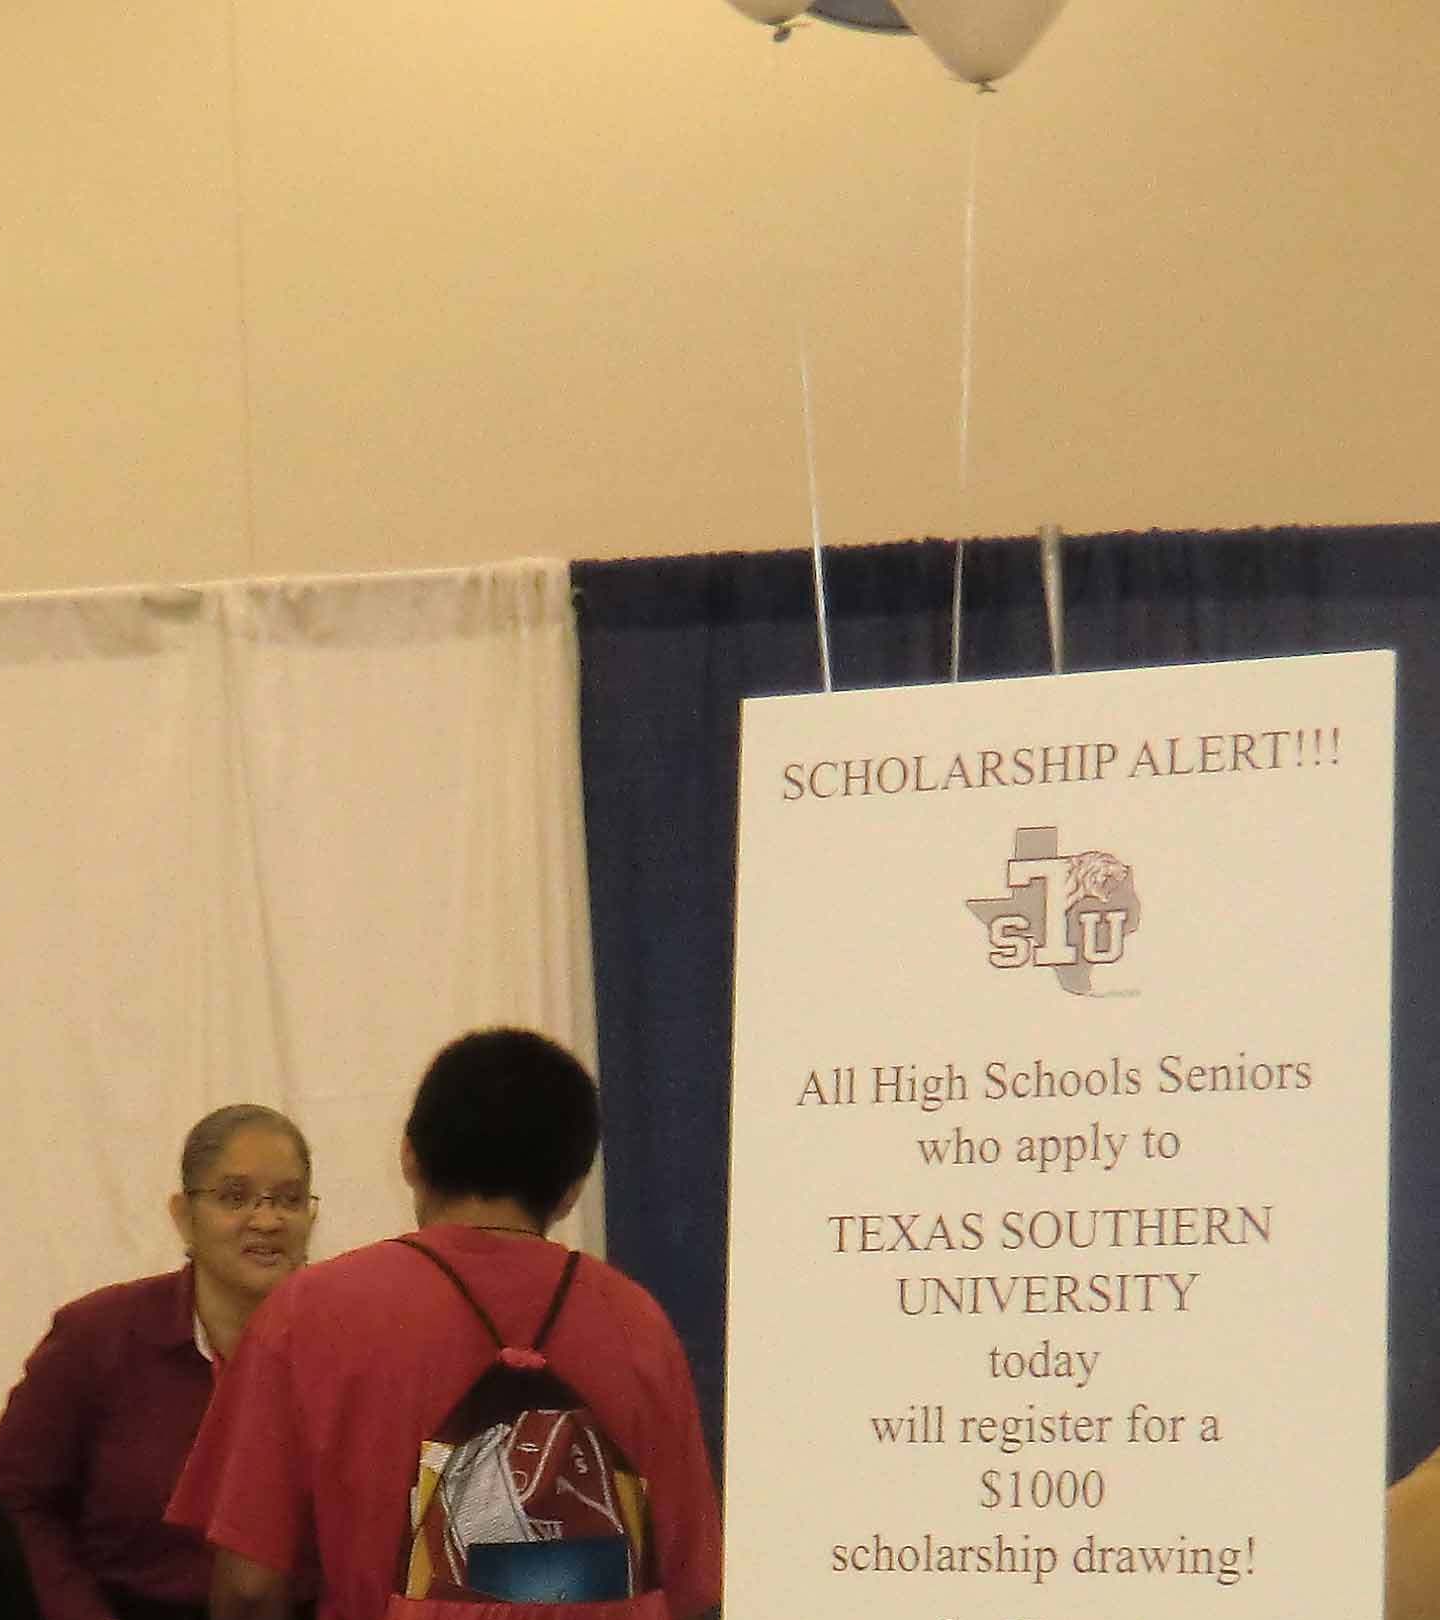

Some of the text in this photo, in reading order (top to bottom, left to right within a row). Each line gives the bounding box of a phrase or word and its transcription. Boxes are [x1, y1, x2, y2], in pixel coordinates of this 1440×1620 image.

[784, 728, 1338, 800] SCHOLARSHIP ALERT!!!
[796, 1052, 1311, 1112] All High Schools Seniors
[917, 1122, 1180, 1173] who apply to
[828, 1206, 1272, 1252] TEXAS SOUTHERN
[896, 1273, 1200, 1315] UNIVERSITY
[989, 1339, 1100, 1388] today
[871, 1404, 1223, 1454] will register for a
[981, 1470, 1104, 1511] $1000
[832, 1534, 1254, 1585] scholarship drawing!
